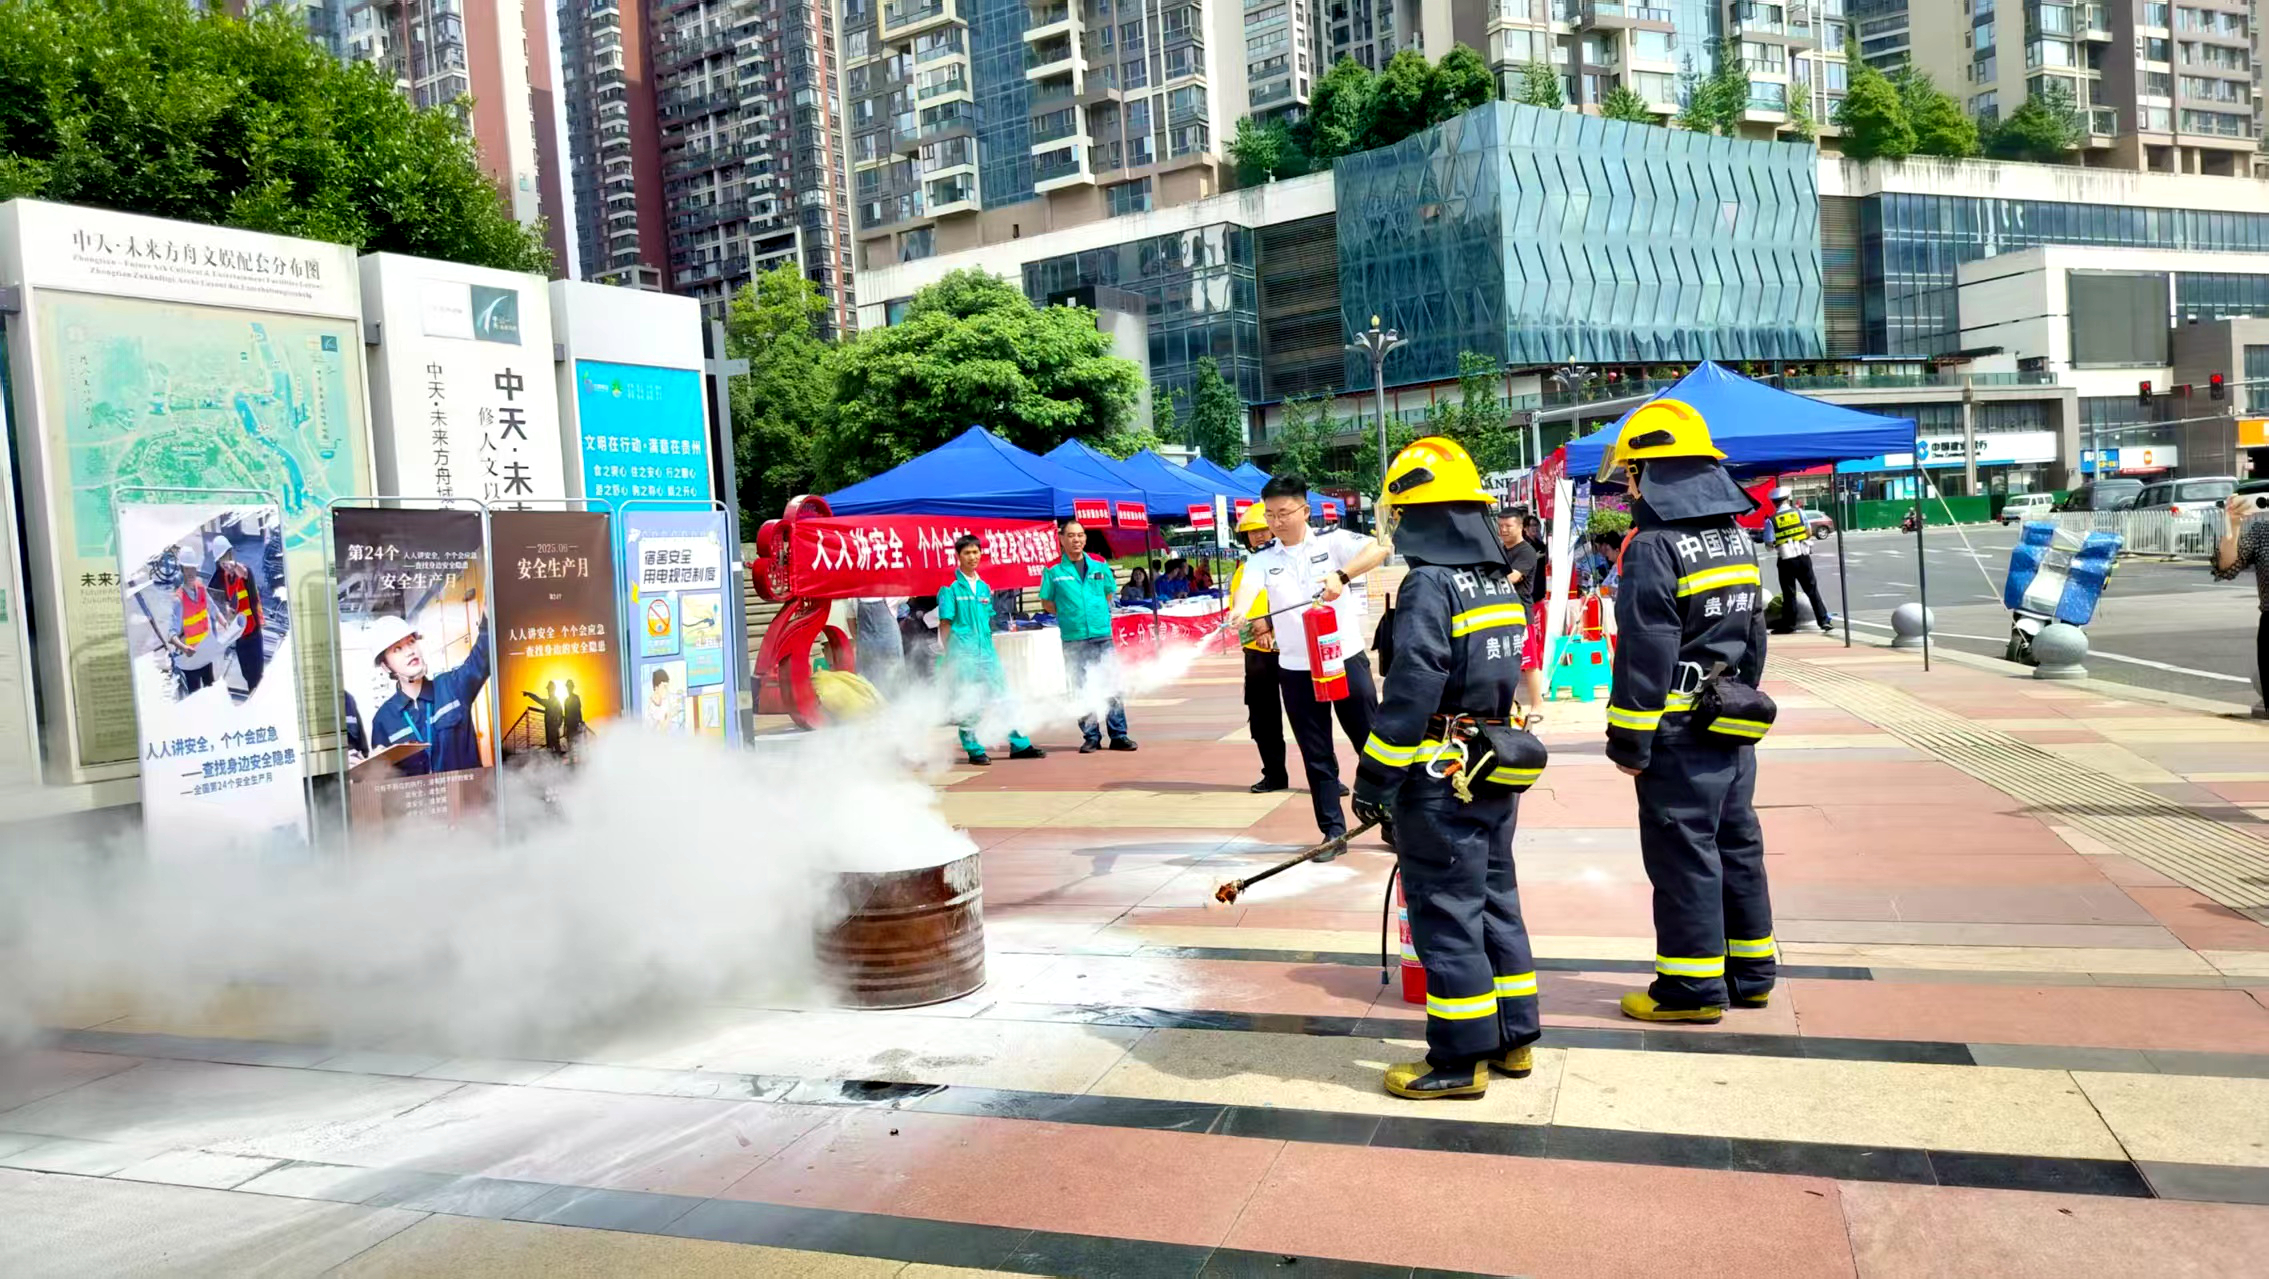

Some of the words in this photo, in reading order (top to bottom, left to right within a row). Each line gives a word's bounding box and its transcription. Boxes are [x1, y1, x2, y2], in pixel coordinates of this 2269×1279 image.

[584, 434, 701, 455] 文明在行动·满意在贵州
[479, 406, 501, 510] 修人文以
[348, 543, 400, 561] 第24个
[643, 549, 692, 566] 宿舍安全
[517, 557, 589, 580] 安全生产月
[643, 566, 718, 584] 用电规范制度
[381, 572, 457, 590] 安全生产月
[509, 626, 555, 641] 人人讲安全
[561, 624, 605, 638] 个个会应急
[146, 726, 279, 760] 人人讲安全，个个会应急
